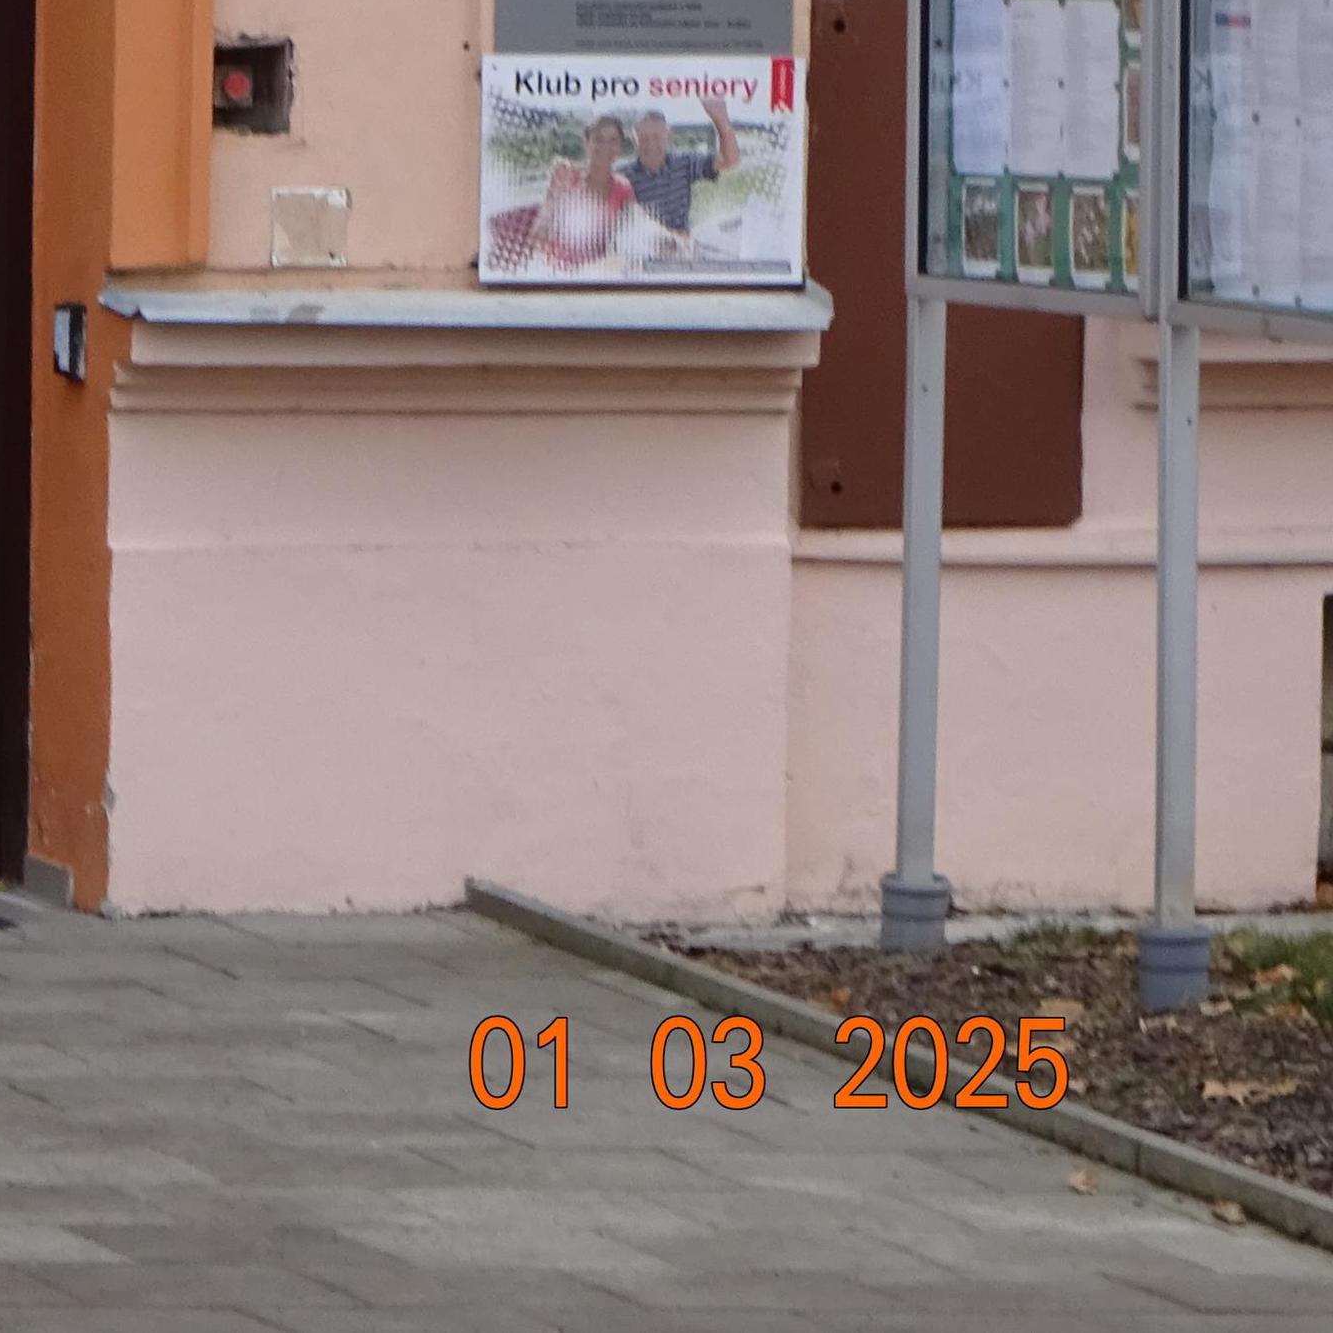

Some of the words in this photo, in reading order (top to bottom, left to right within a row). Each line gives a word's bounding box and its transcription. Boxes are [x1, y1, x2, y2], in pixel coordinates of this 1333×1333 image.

[514, 68, 581, 96] Klub
[591, 76, 640, 101] pro
[649, 70, 758, 103] seniory
